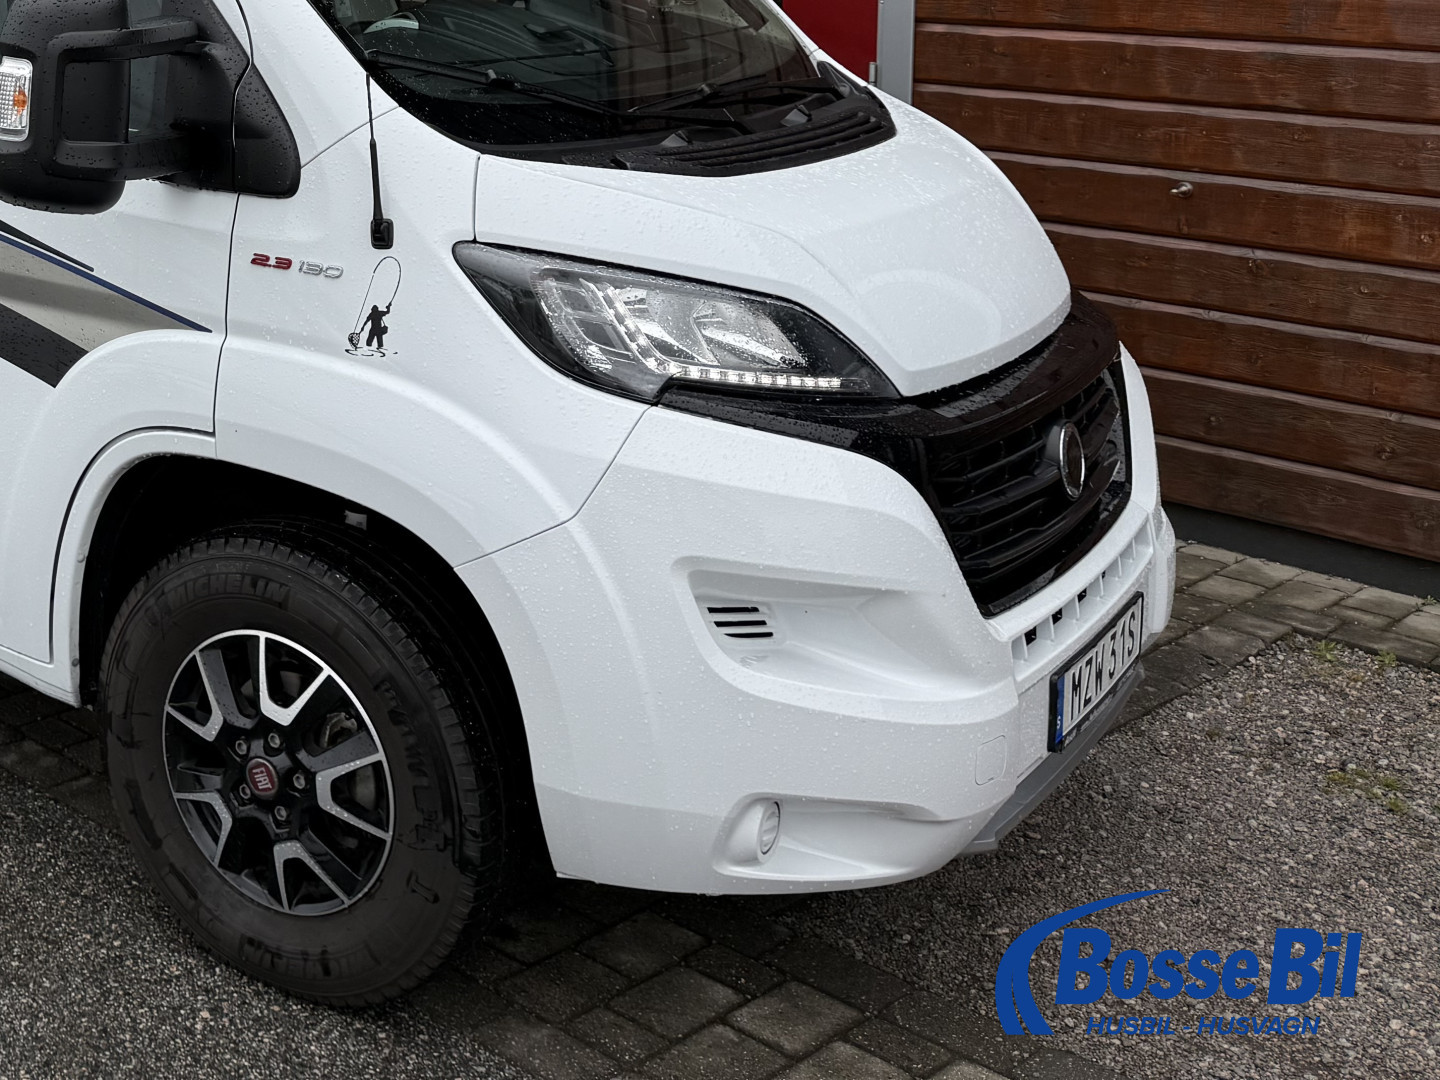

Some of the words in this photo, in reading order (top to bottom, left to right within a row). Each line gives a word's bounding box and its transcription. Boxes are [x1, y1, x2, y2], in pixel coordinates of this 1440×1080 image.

[250, 252, 293, 271] 2.3
[298, 259, 345, 279] 130
[167, 573, 292, 610] MICHELIN
[1071, 642, 1106, 722] MZW
[1108, 610, 1137, 680] 31S
[252, 767, 273, 790] FIAT
